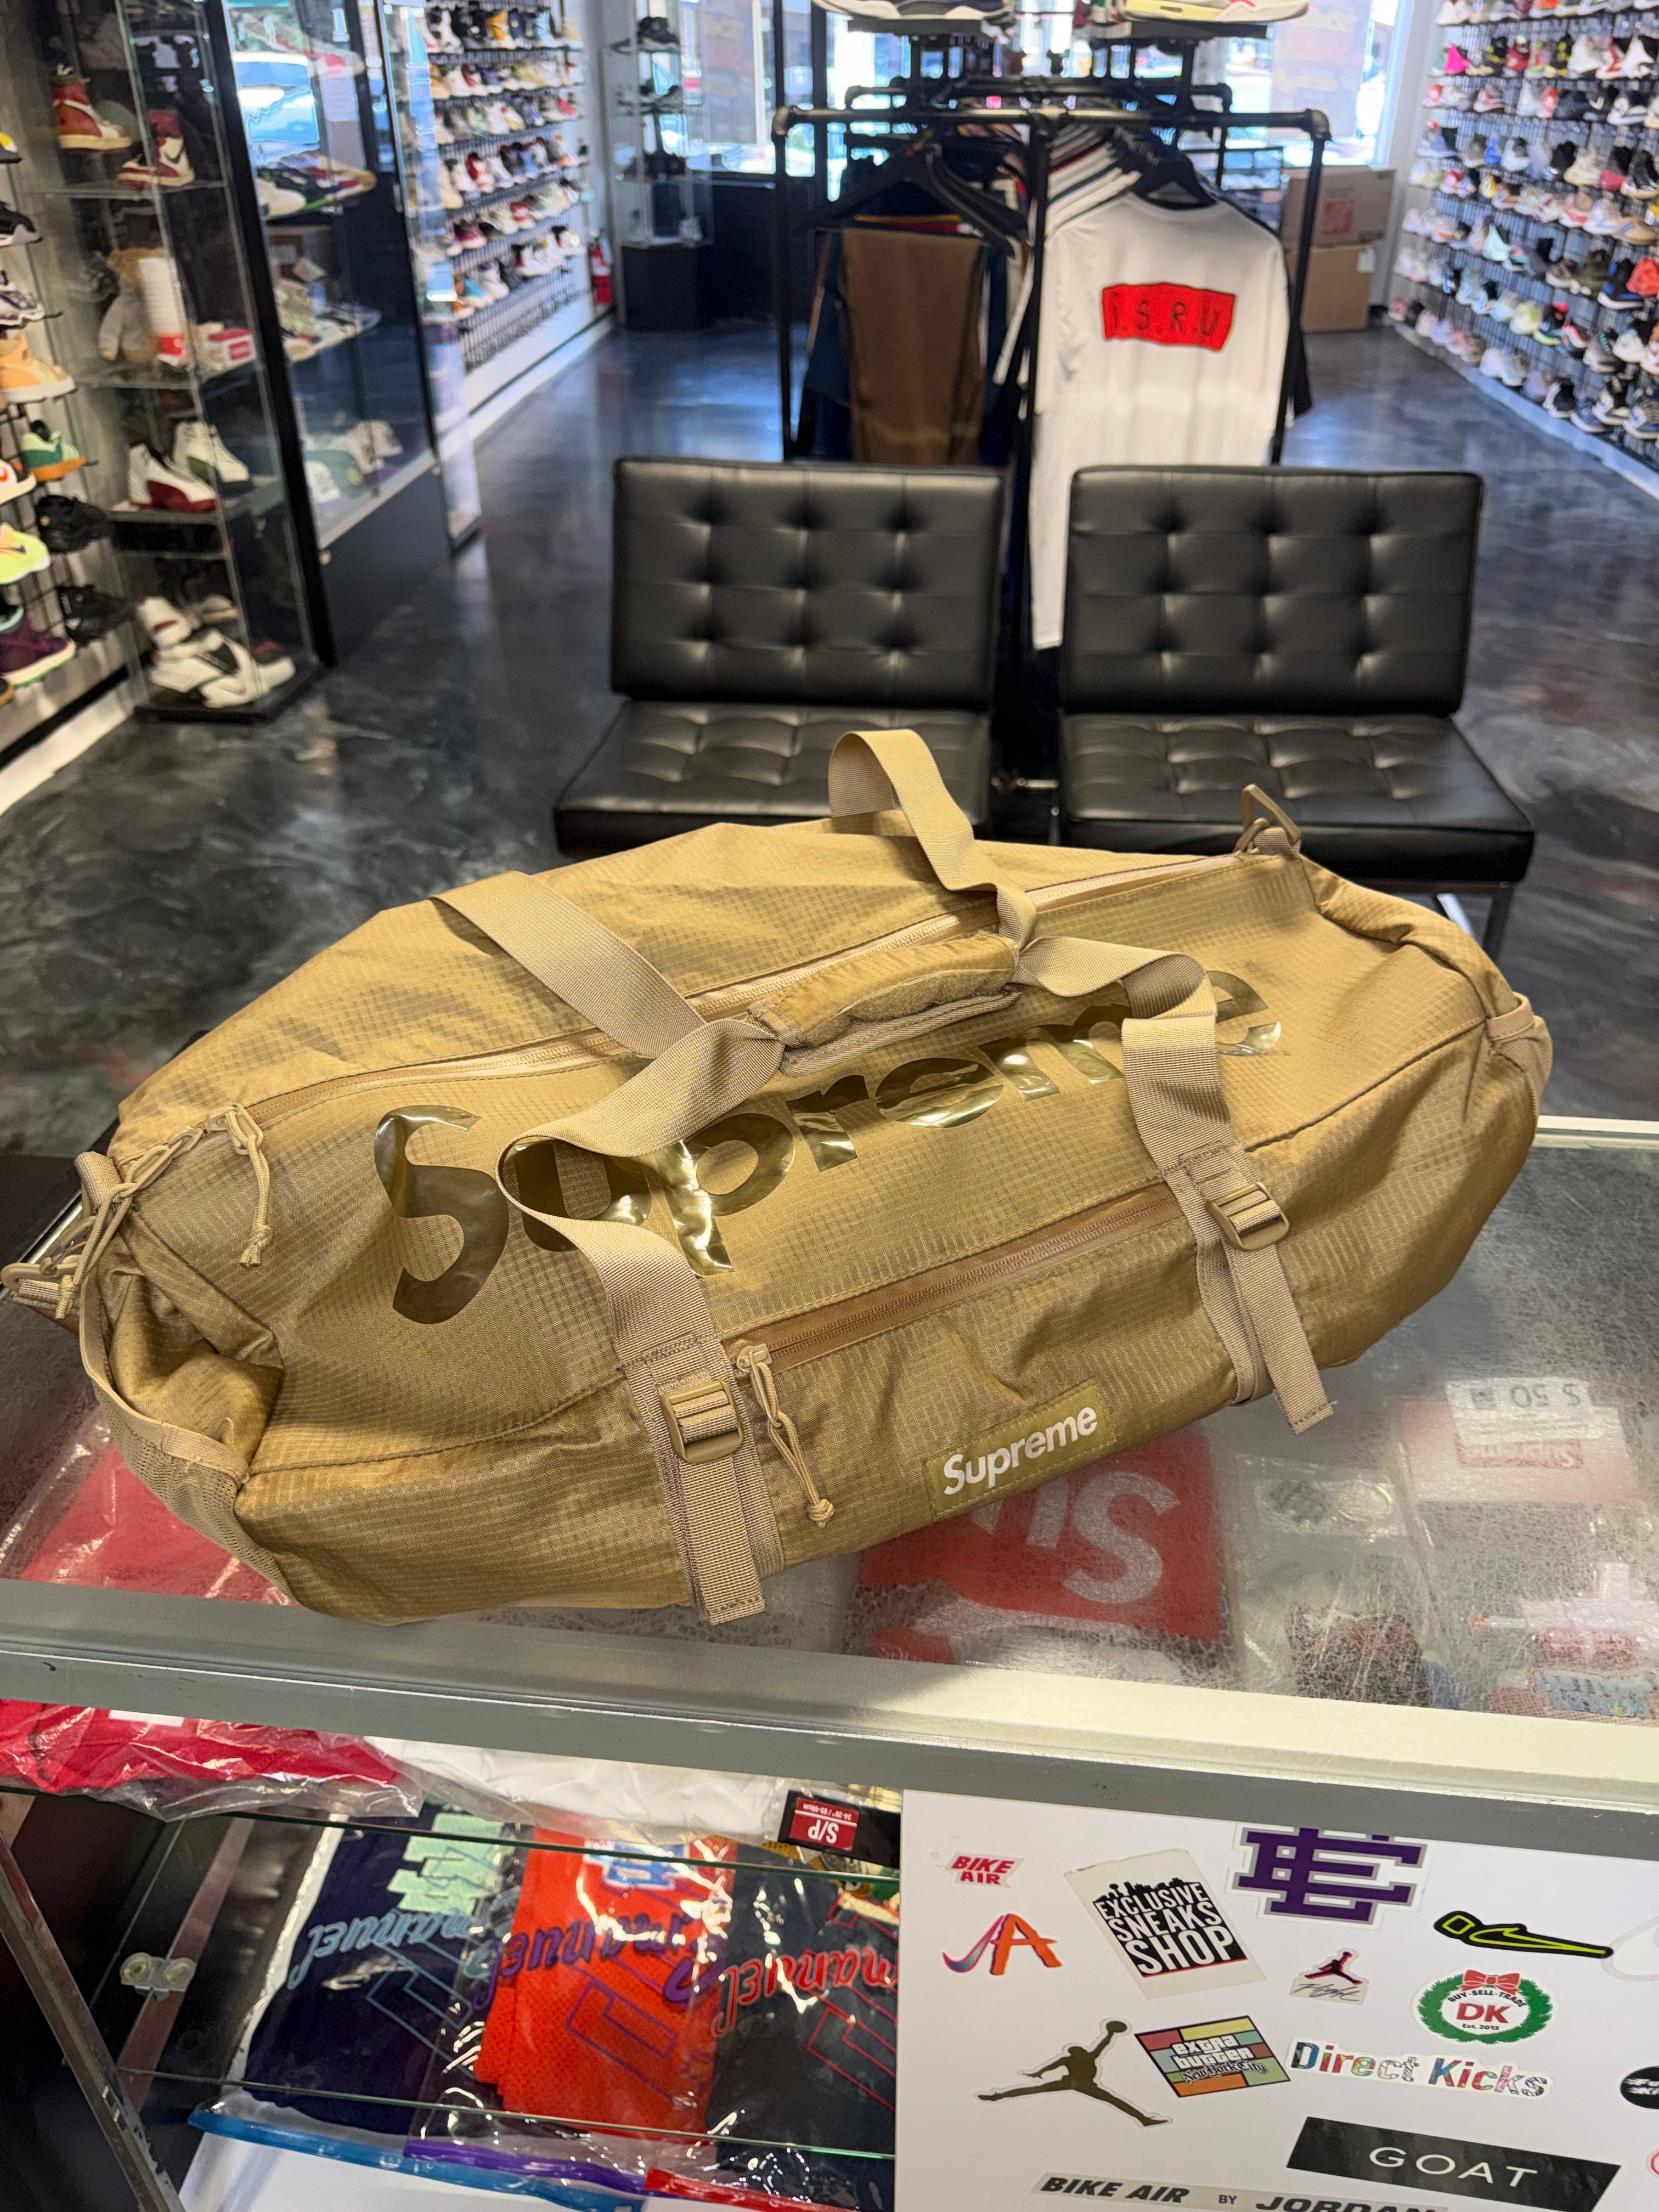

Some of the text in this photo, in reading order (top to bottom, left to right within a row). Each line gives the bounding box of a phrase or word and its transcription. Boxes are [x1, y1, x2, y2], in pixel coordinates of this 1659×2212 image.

[943, 1407, 1098, 1496] Supreme
[808, 1819, 840, 1844] S/P
[951, 1855, 1015, 1874] BIKE
[960, 1871, 1001, 1885] AIR
[1094, 1883, 1210, 1920] EXCLUSIVE
[1108, 1901, 1223, 1942] SNEAKS
[1125, 1925, 1234, 1974] SHOP
[1456, 2002, 1510, 2023] DK
[1182, 2060, 1268, 2084] New York City
[1291, 2041, 1548, 2097] Direct Kicks
[1369, 2147, 1538, 2187] GOAT
[1040, 2177, 1124, 2197] BIKE
[1125, 2185, 1190, 2203] AIR
[1218, 2194, 1237, 2204] BY
